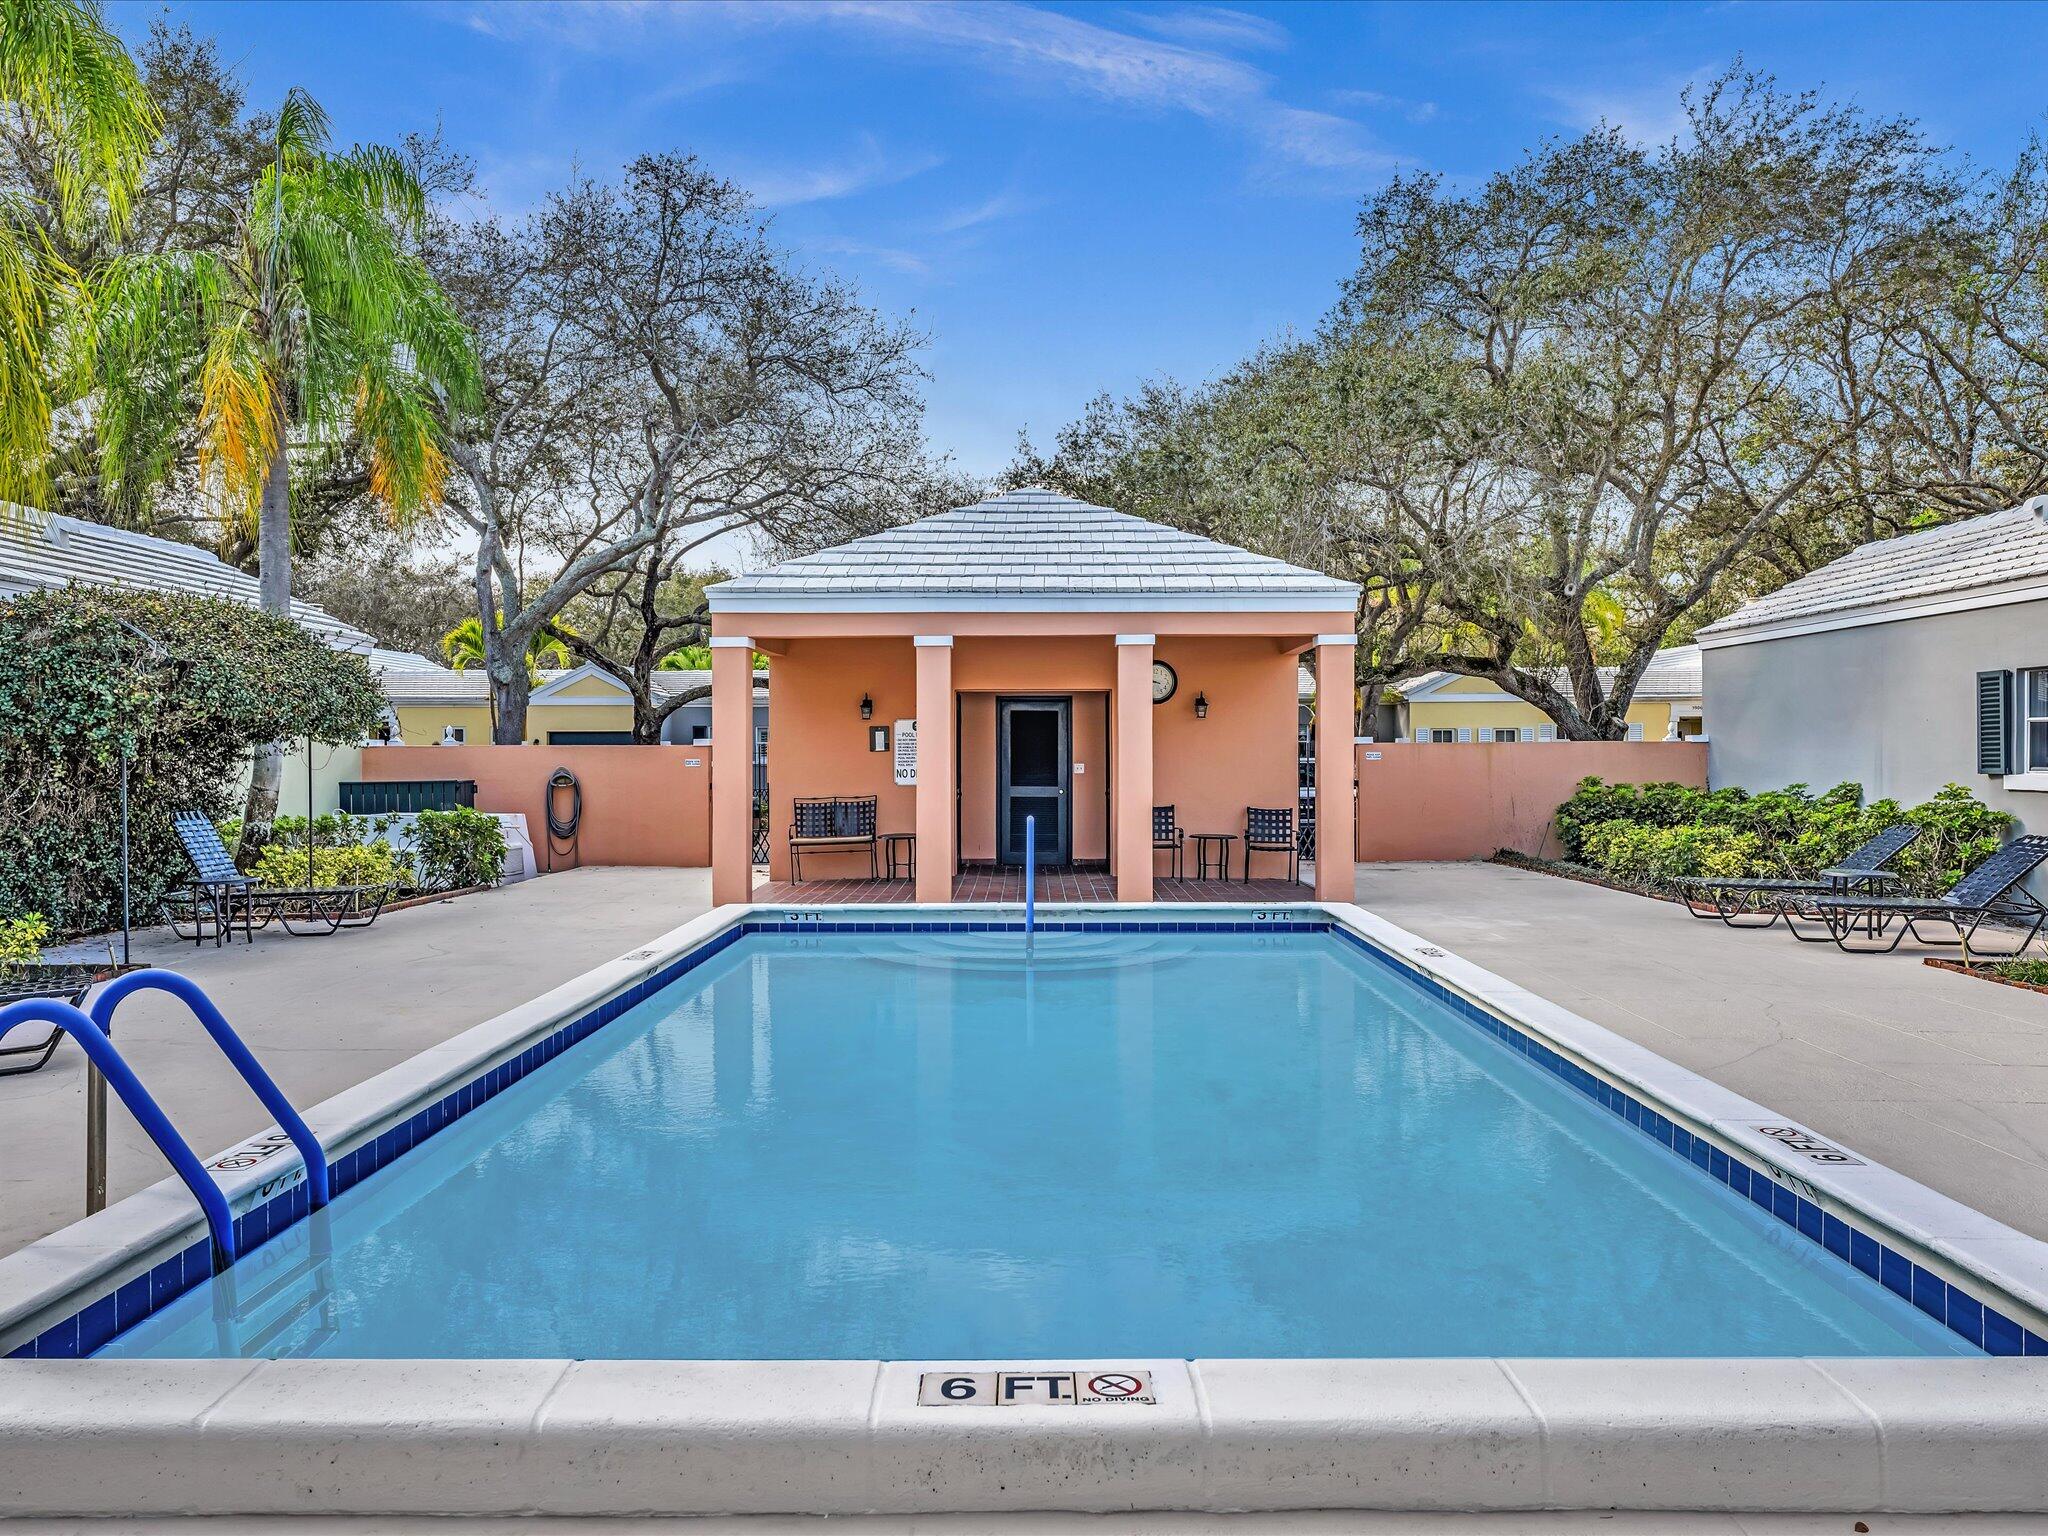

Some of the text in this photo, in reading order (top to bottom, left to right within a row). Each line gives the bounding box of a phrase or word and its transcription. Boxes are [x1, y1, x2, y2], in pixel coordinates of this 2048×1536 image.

[896, 769, 908, 778] NO
[790, 913, 822, 921] 3 FT.
[1257, 912, 1289, 920] 3 FT.
[941, 1376, 1072, 1400] 6 FT.
